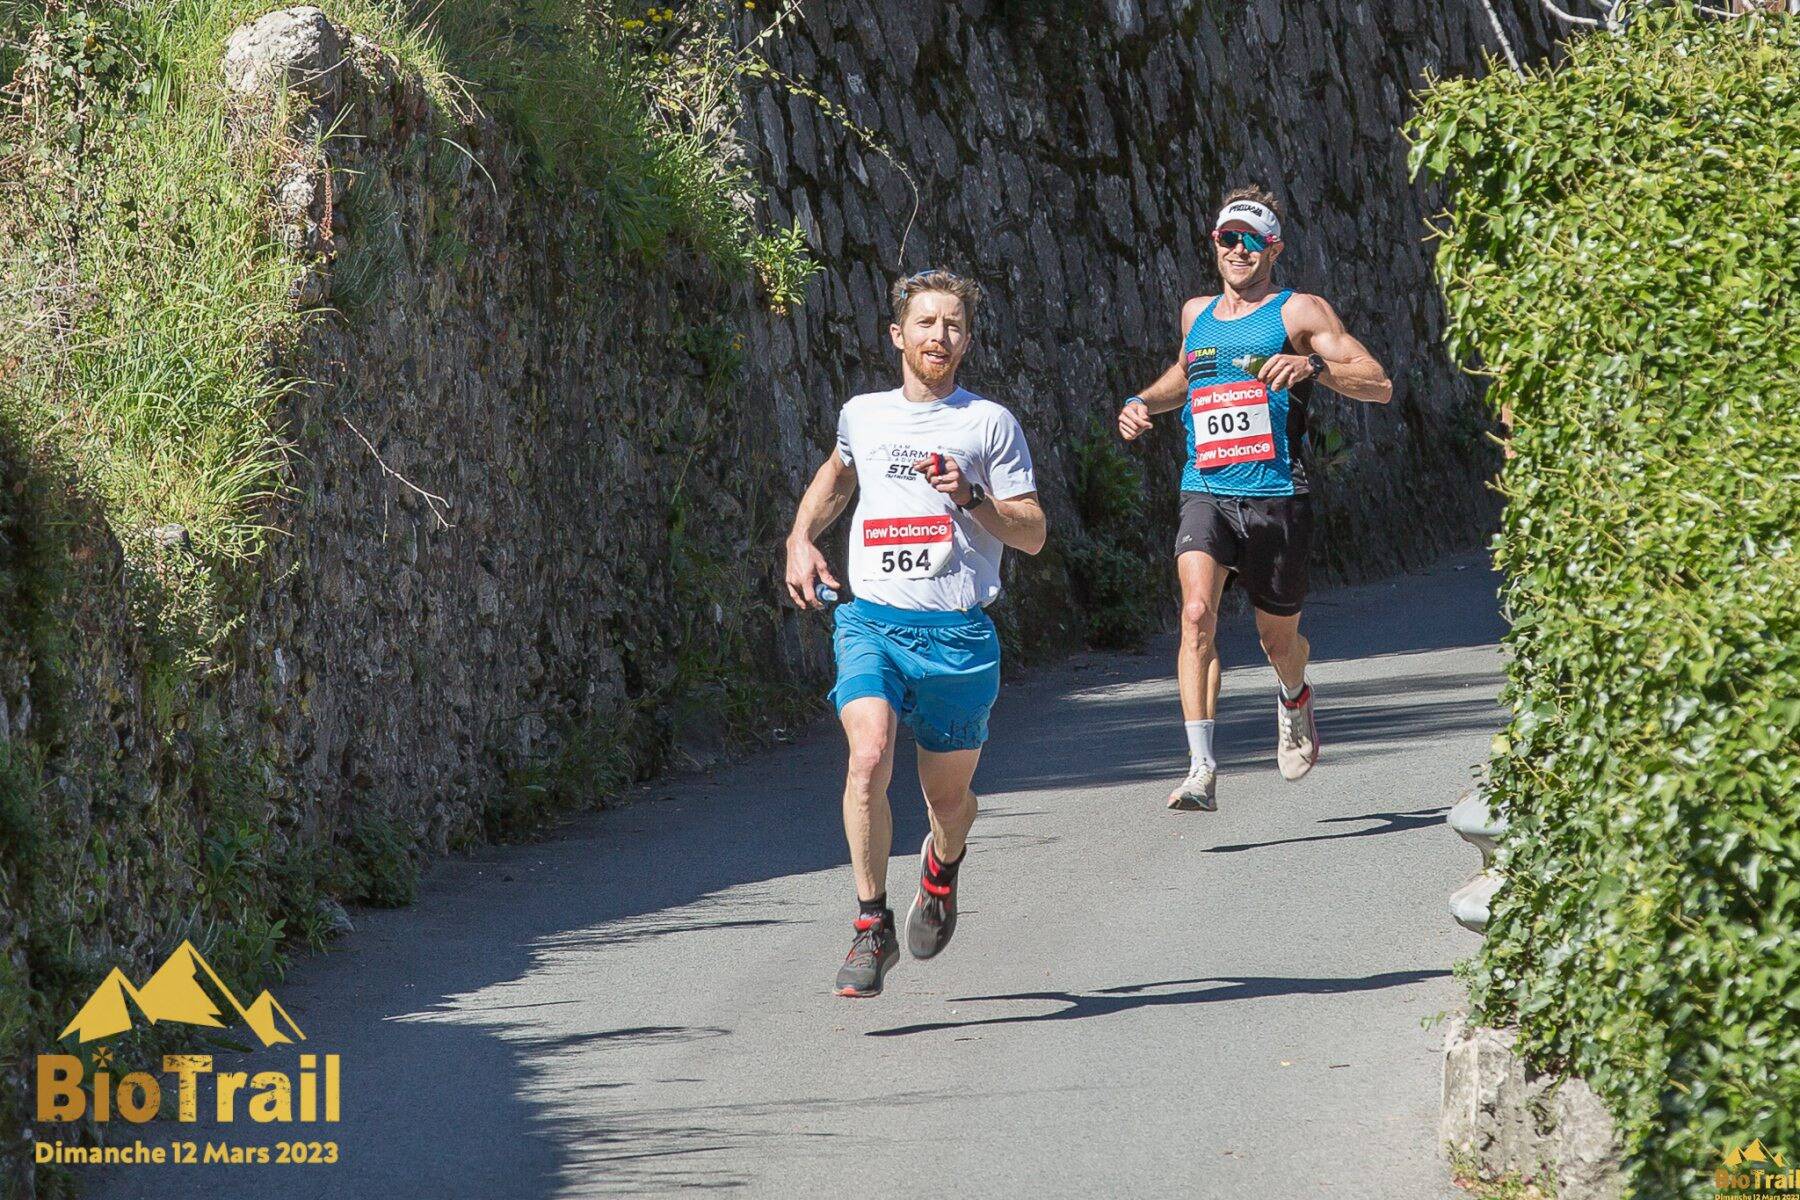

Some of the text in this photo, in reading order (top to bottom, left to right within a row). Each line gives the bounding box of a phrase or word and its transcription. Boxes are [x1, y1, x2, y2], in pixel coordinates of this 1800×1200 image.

[1194, 388, 1263, 407] new balance
[1208, 411, 1250, 435] 603
[891, 449, 929, 458] GARM
[1199, 443, 1270, 461] new balance
[866, 524, 948, 540] new balance
[882, 549, 931, 573] 564
